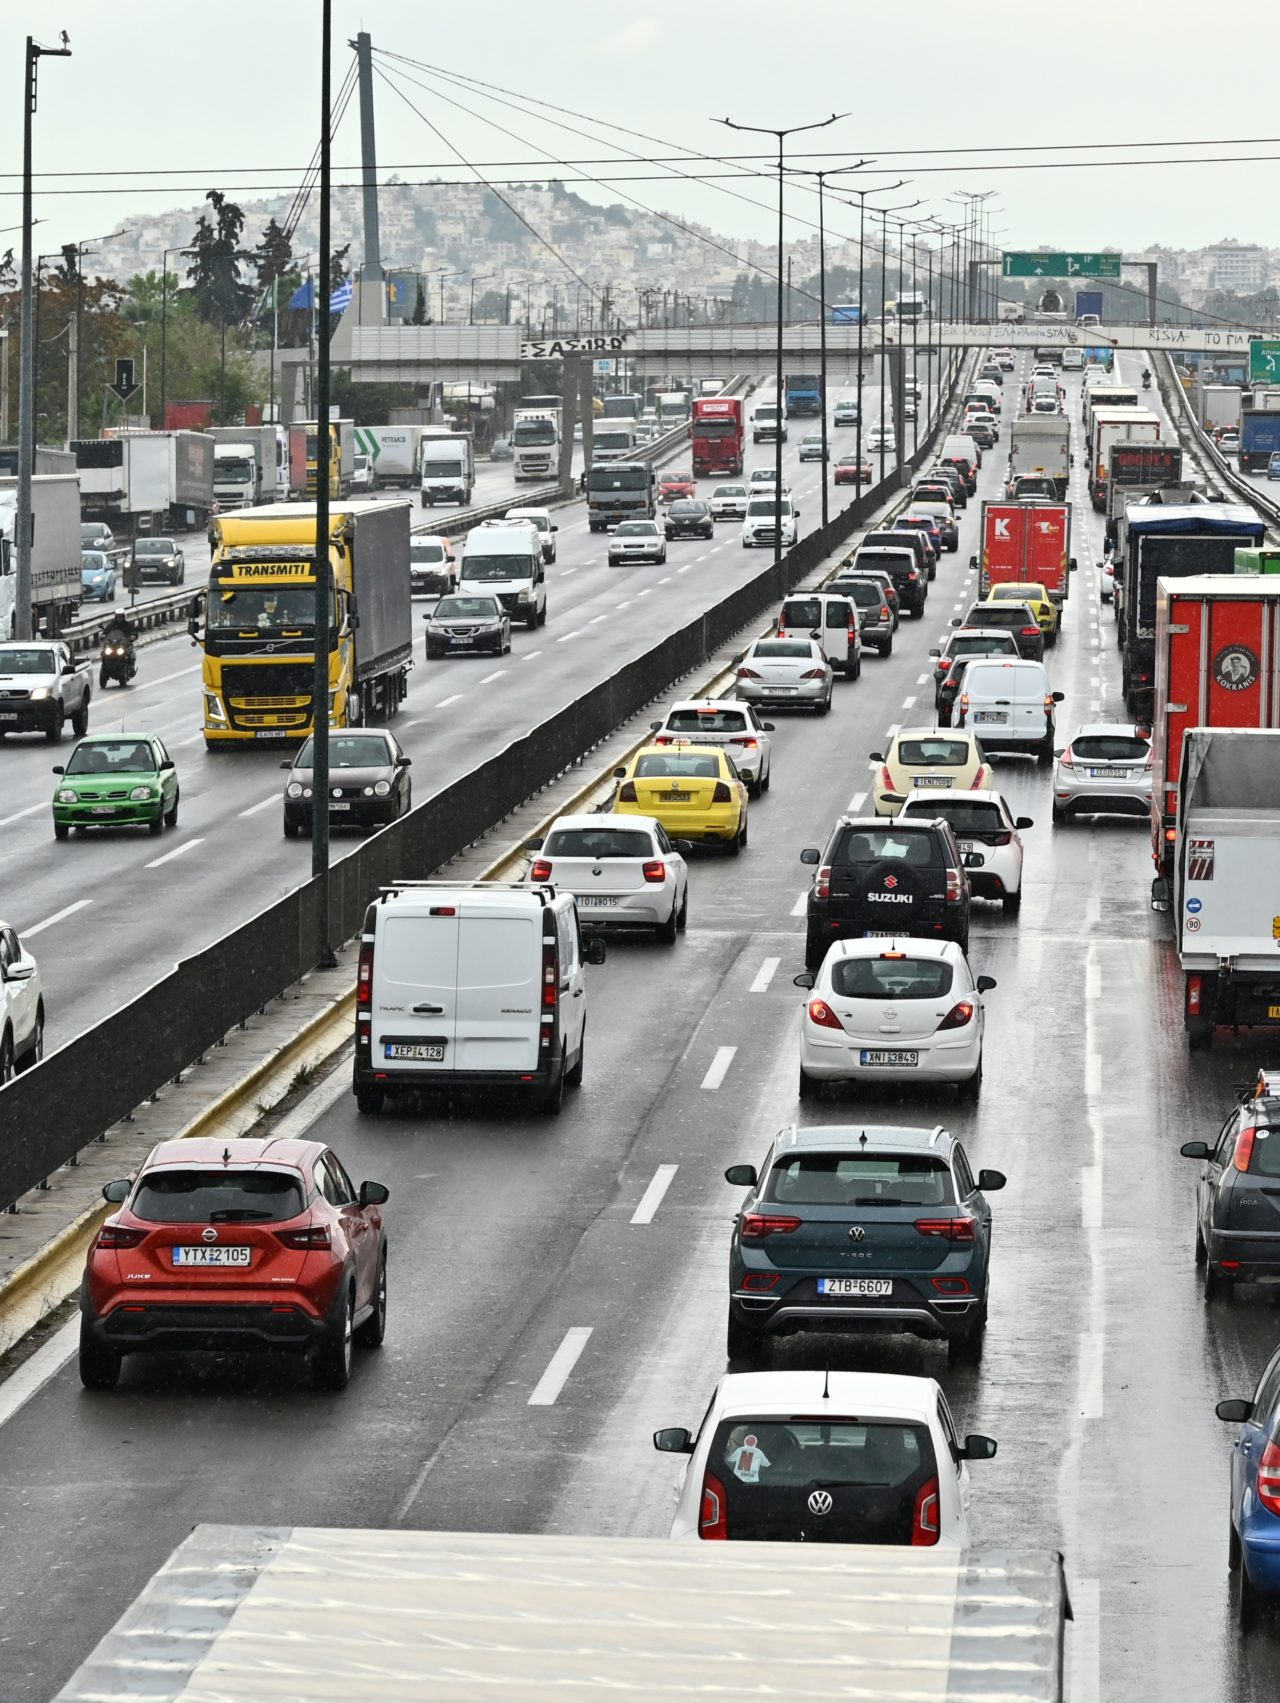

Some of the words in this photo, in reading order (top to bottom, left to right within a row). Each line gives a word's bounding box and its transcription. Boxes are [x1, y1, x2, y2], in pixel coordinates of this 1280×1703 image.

[994, 518, 1011, 536] K
[237, 565, 305, 577] TRANSMITI
[1216, 674, 1256, 691] KOKRANIS
[867, 892, 914, 904] SUZUKI
[1188, 920, 1199, 928] 90
